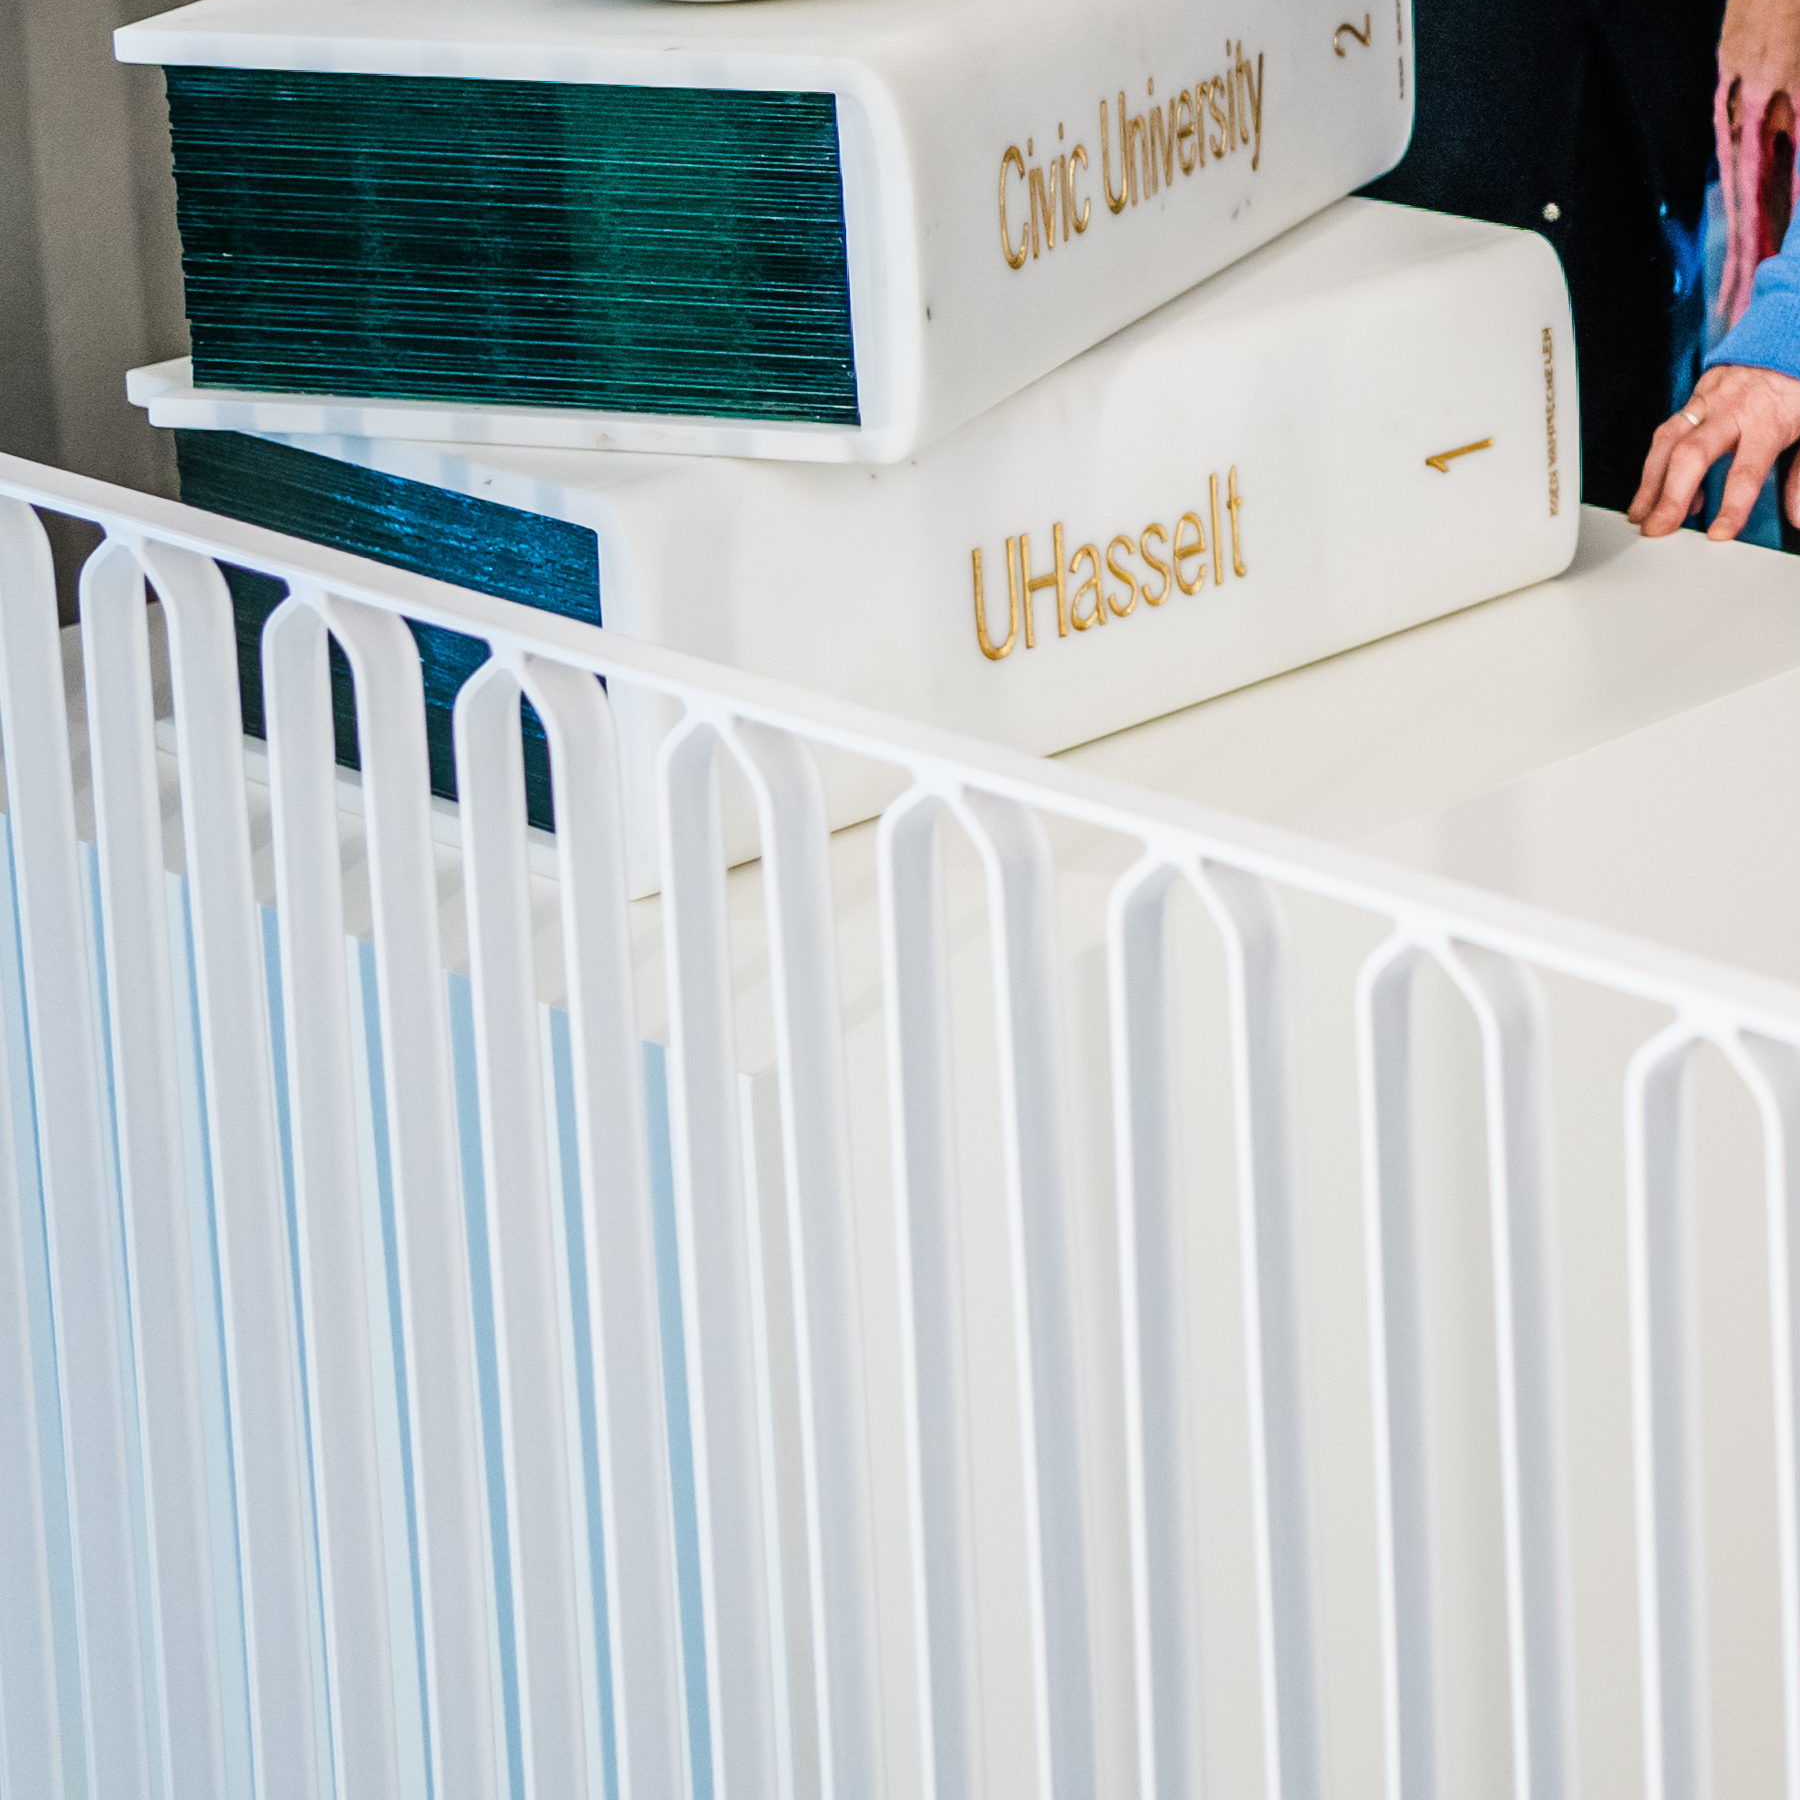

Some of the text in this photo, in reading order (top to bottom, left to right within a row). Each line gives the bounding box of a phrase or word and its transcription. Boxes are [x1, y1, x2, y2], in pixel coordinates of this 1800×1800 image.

[1334, 13, 1371, 58] 2
[999, 39, 1265, 271] Civic University
[1424, 437, 1495, 474] 1
[971, 464, 1247, 662] UHasselt
